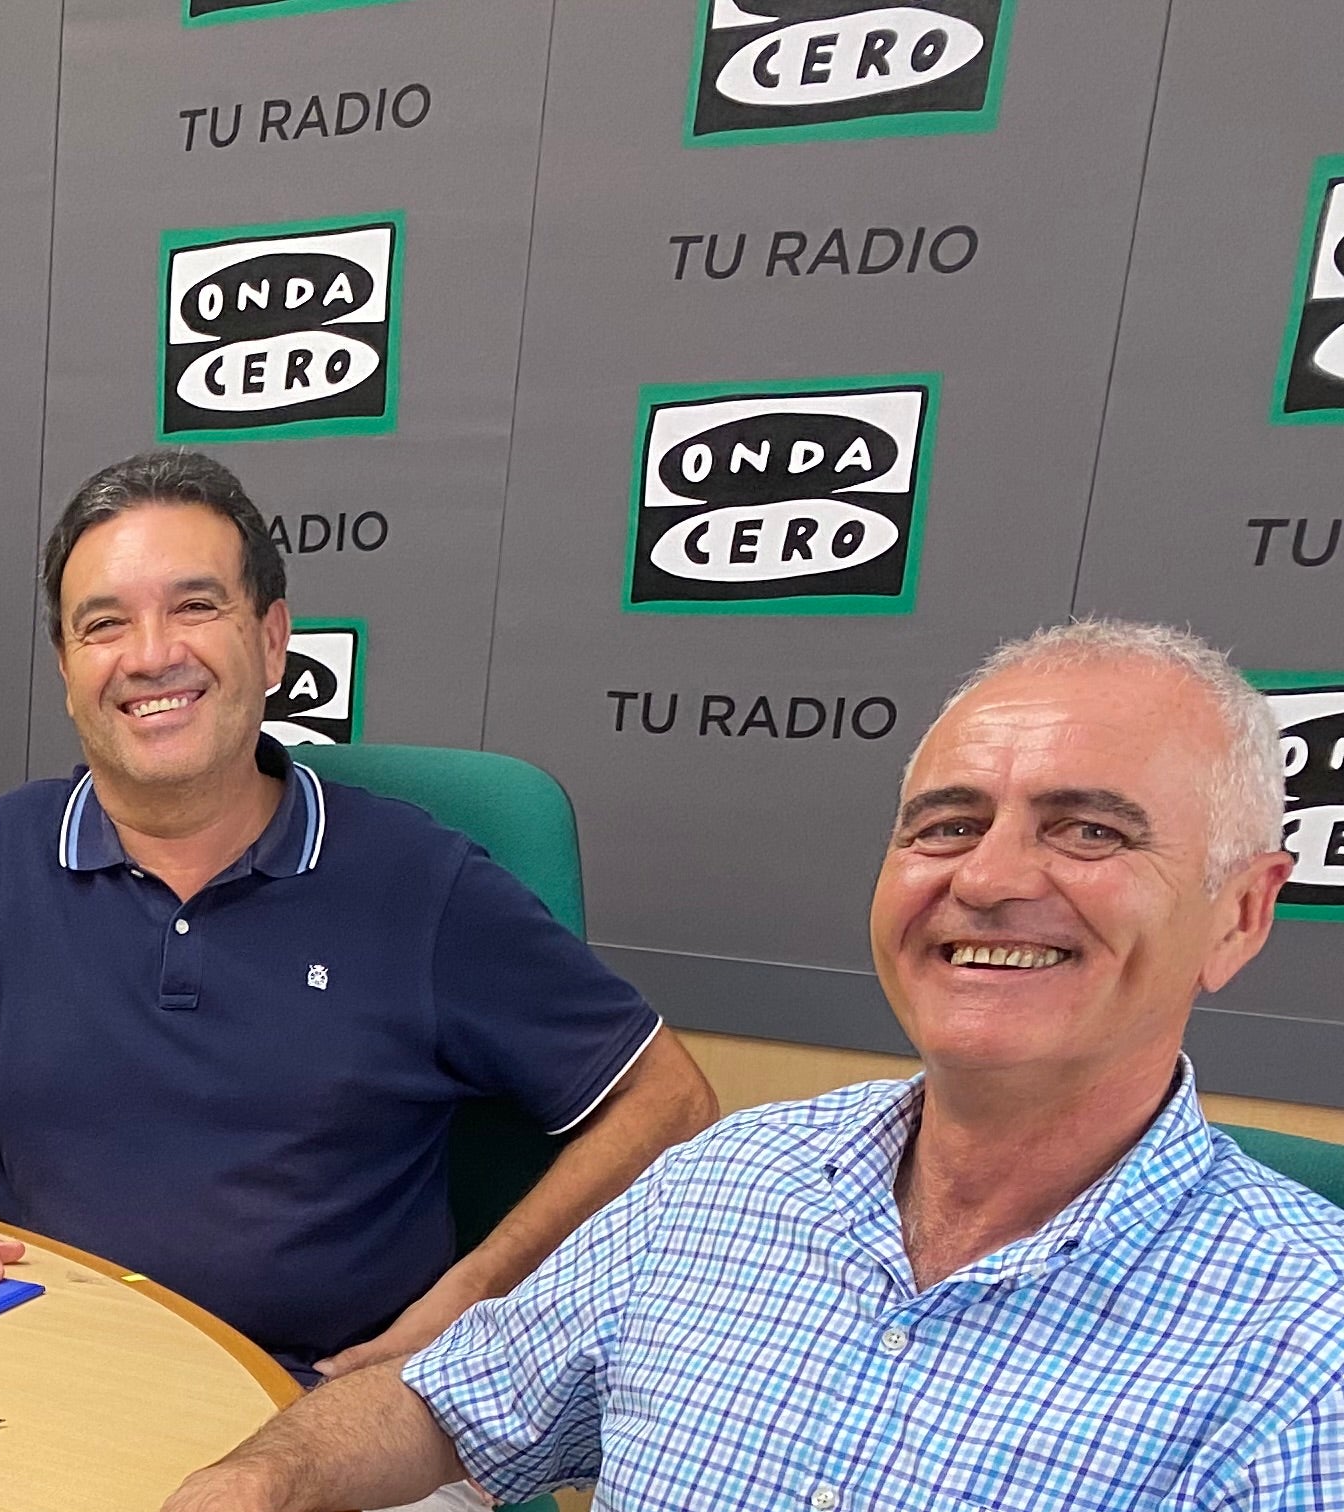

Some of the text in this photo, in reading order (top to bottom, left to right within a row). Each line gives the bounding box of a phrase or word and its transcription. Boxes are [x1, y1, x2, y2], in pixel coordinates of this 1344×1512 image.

[752, 29, 948, 88] CERO
[179, 83, 431, 152] TU RADIO
[669, 225, 979, 281] TU RADIO
[197, 271, 354, 321] ONDA
[204, 347, 352, 396] CERO
[680, 436, 873, 484] ONDA
[268, 510, 389, 554] ADIO
[683, 518, 866, 566] CERO
[1247, 518, 1343, 567] TU
[607, 690, 898, 740] TU RADIO
